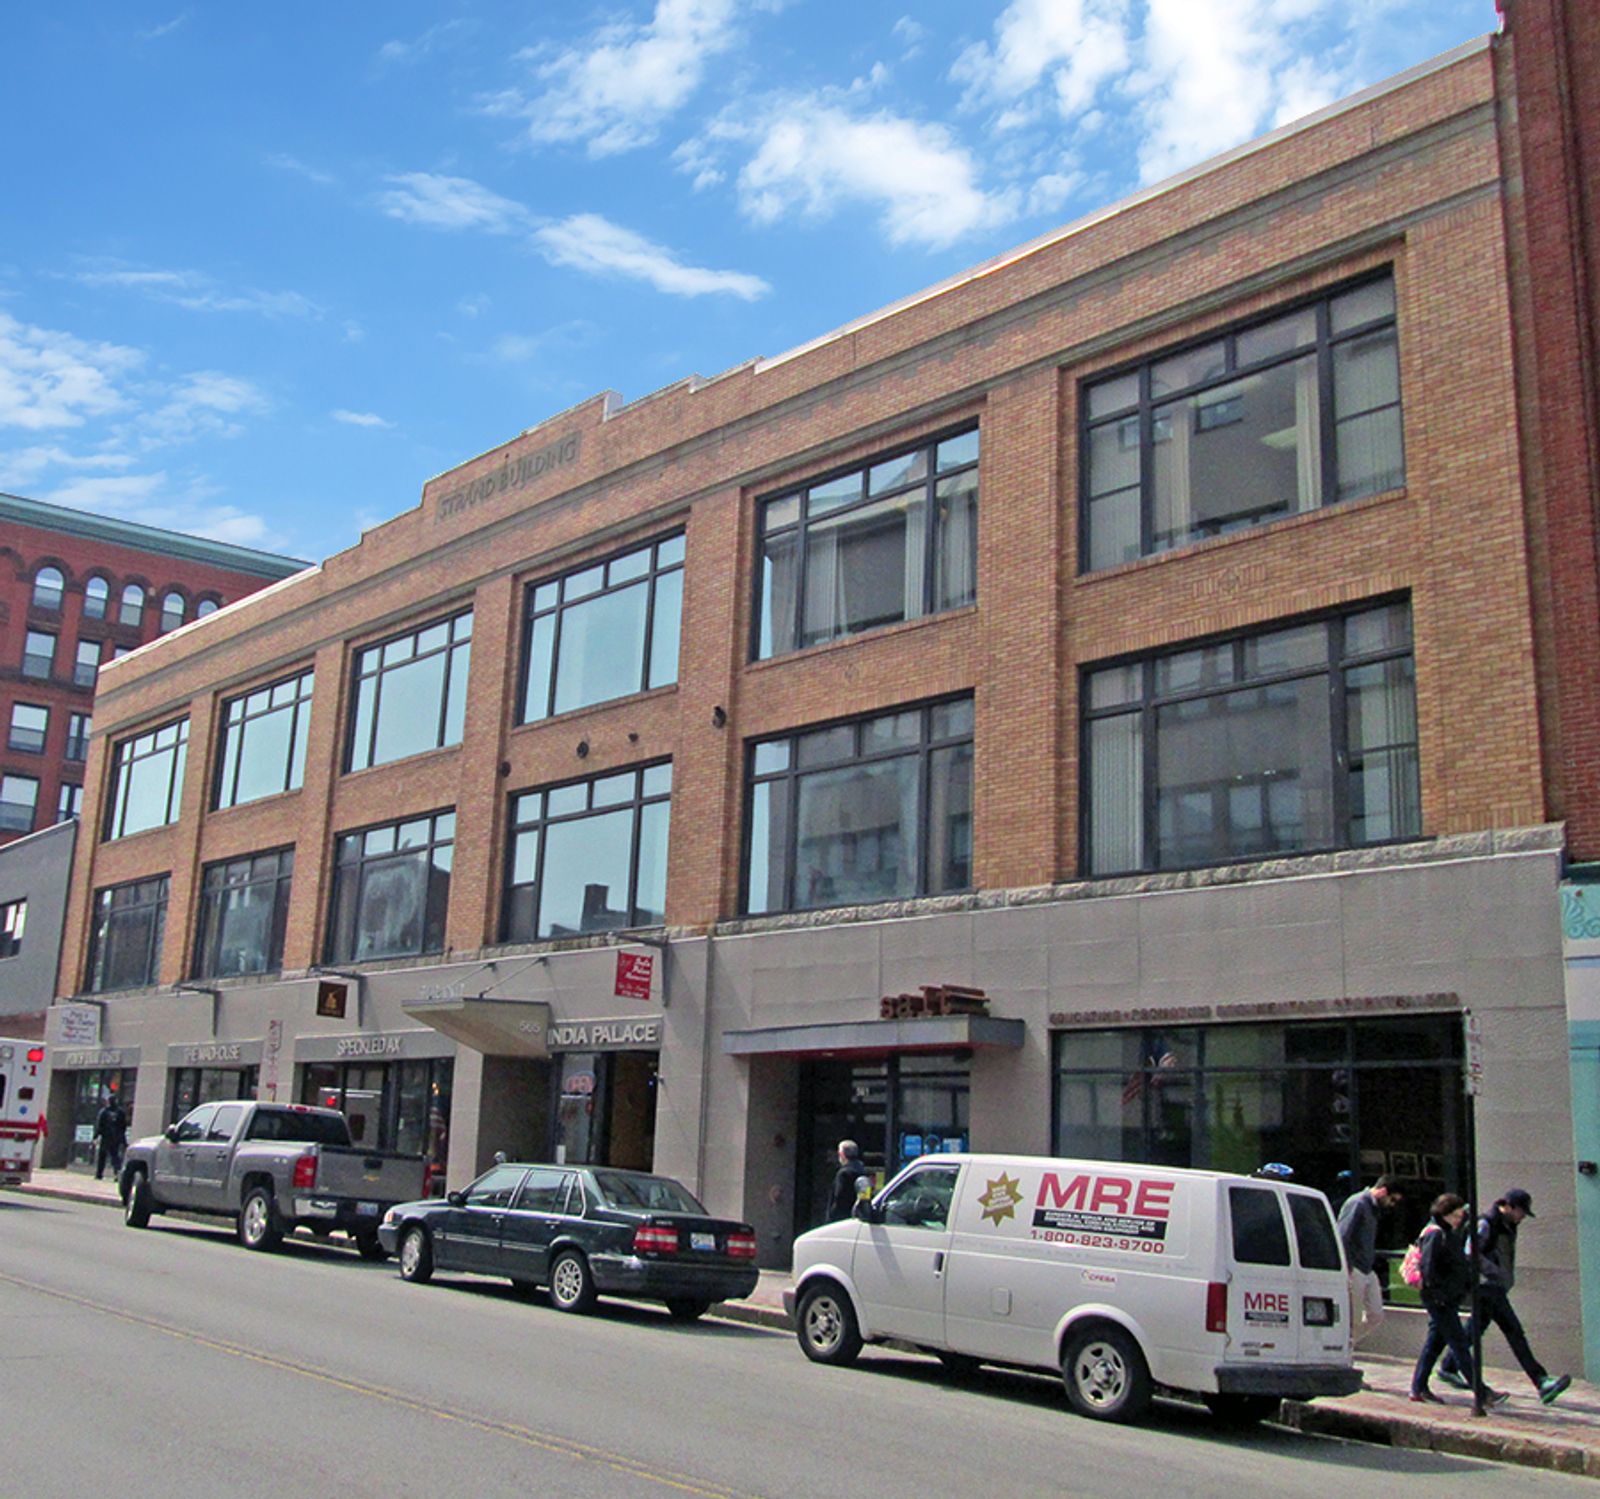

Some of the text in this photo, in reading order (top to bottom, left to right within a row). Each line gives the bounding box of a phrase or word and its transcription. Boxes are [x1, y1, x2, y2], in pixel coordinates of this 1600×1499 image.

[439, 437, 577, 519] STRAND BUILDING
[548, 1023, 657, 1045] INDIA PALACE
[337, 1037, 386, 1056] SPECKLED
[1036, 1172, 1176, 1219] MRE
[1244, 1292, 1289, 1312] MRE
